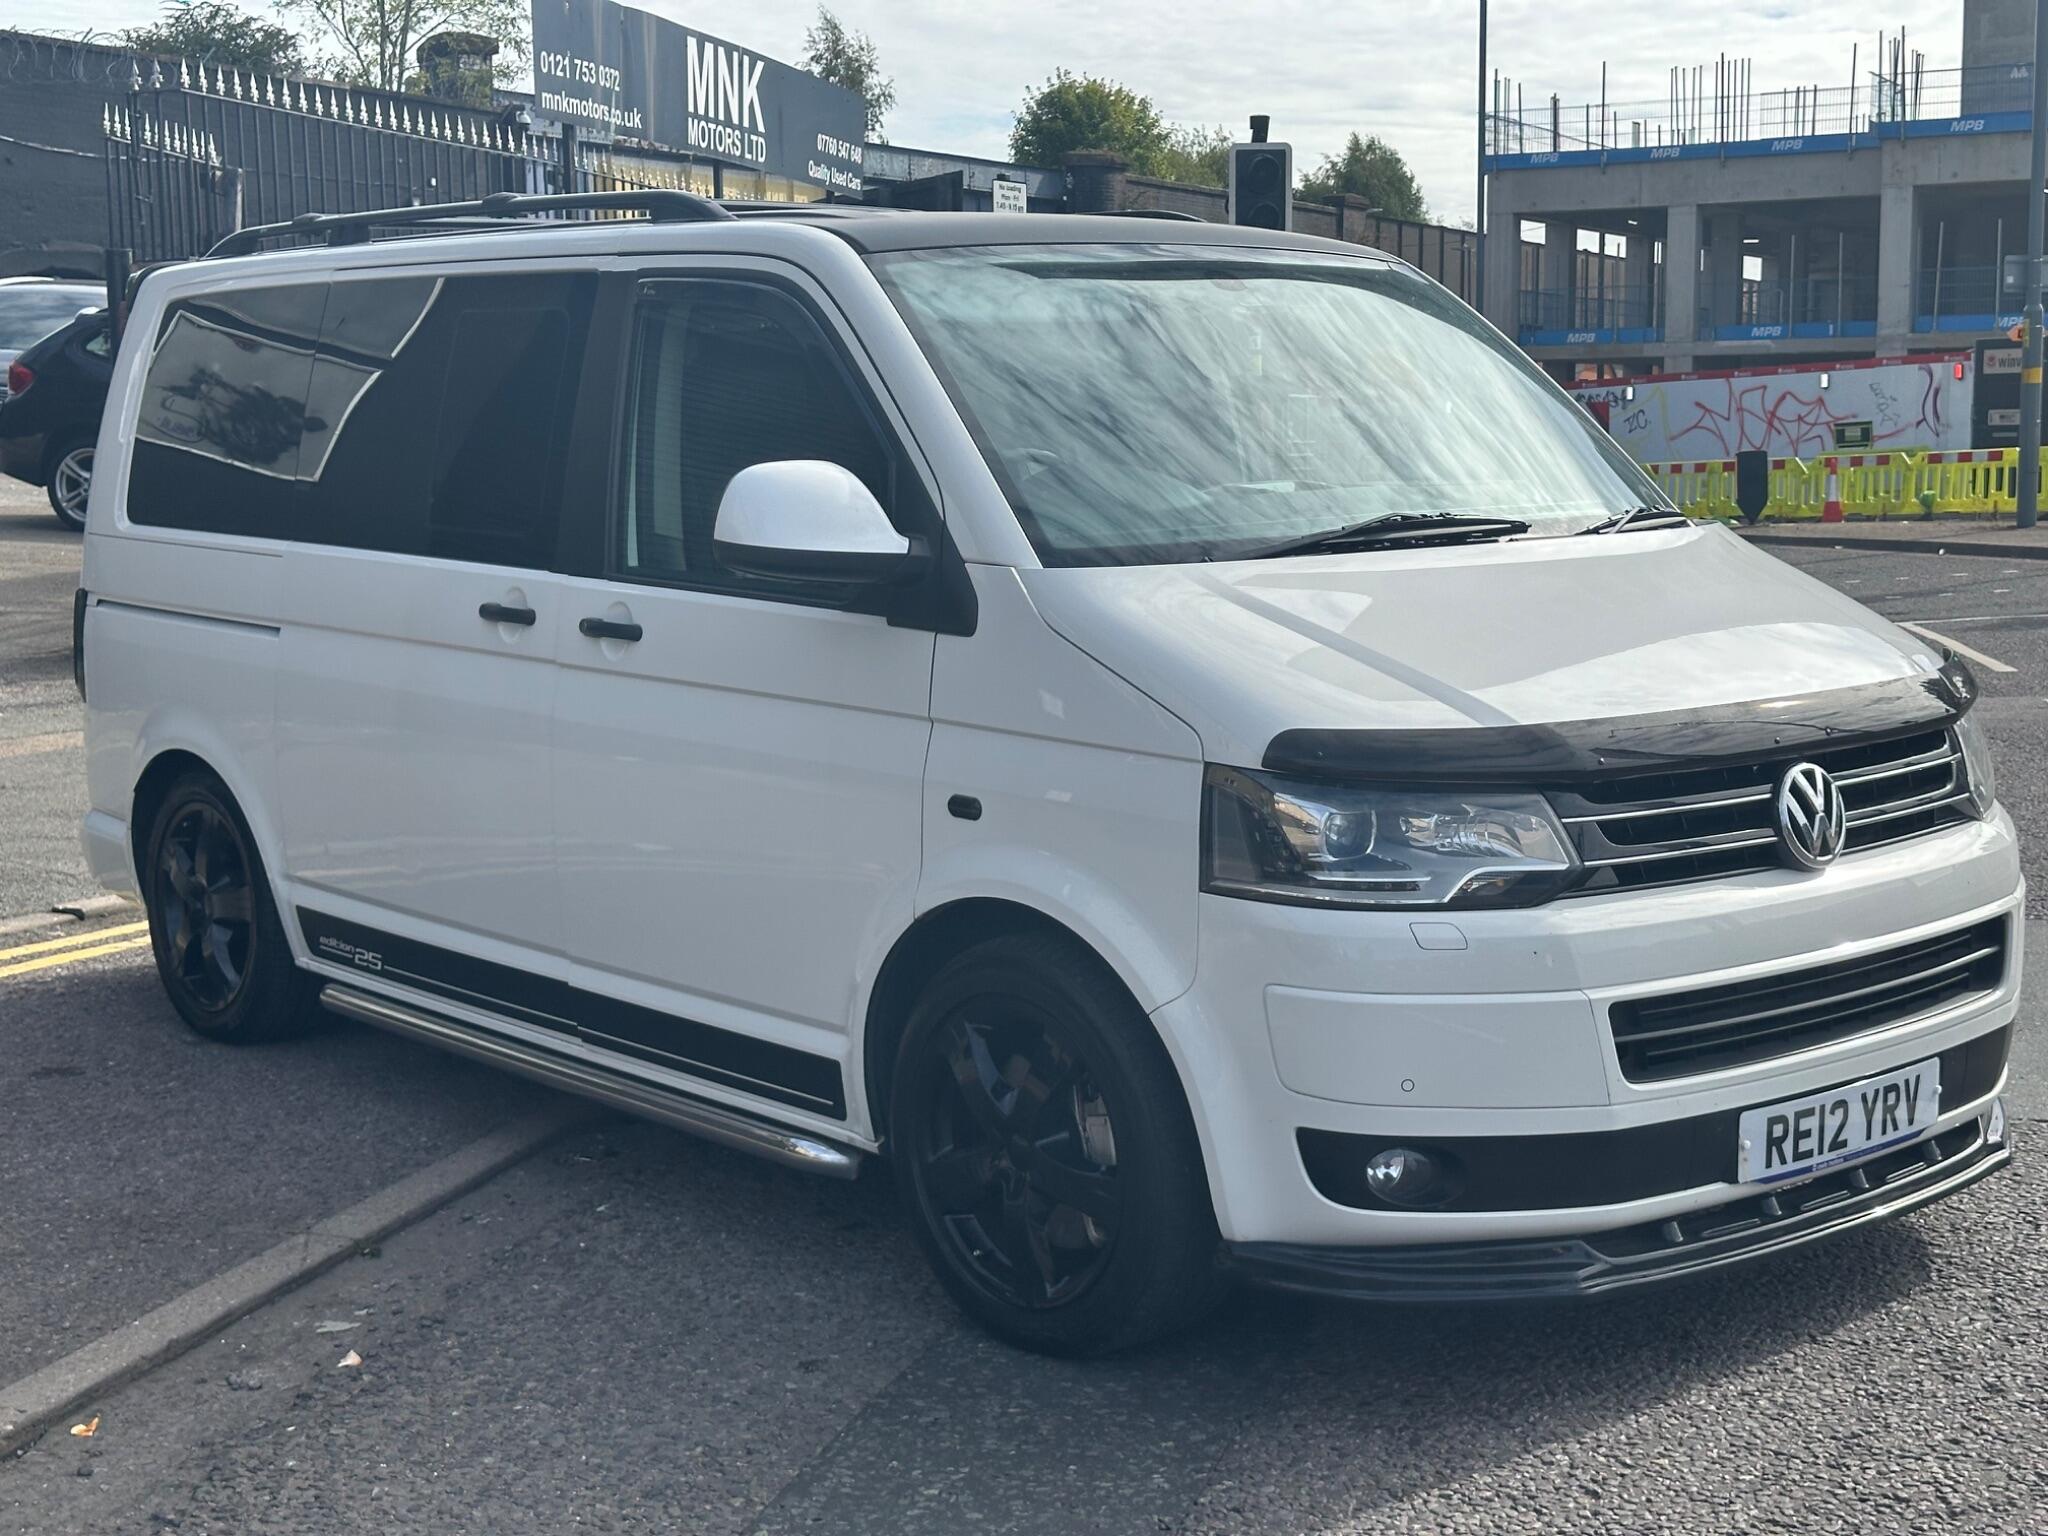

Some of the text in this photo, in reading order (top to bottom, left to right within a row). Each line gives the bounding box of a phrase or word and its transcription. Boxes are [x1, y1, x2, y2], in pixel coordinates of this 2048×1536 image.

[540, 50, 621, 92] 0121 753 0372
[687, 35, 766, 133] MNK
[541, 90, 642, 129] mnkmotors.co.uk
[687, 117, 766, 163] MOTORS LTD
[1950, 119, 1984, 132] MPB
[1530, 152, 1560, 164] MPB
[1650, 147, 1680, 159] MPB
[1771, 138, 1804, 152] MPB
[808, 160, 862, 191] Quality Used Cars
[1567, 333, 1596, 343] MPB
[1751, 326, 1783, 337] MPB
[319, 936, 382, 970] edition 25
[1765, 1073, 1921, 1169] RE12 YRV
